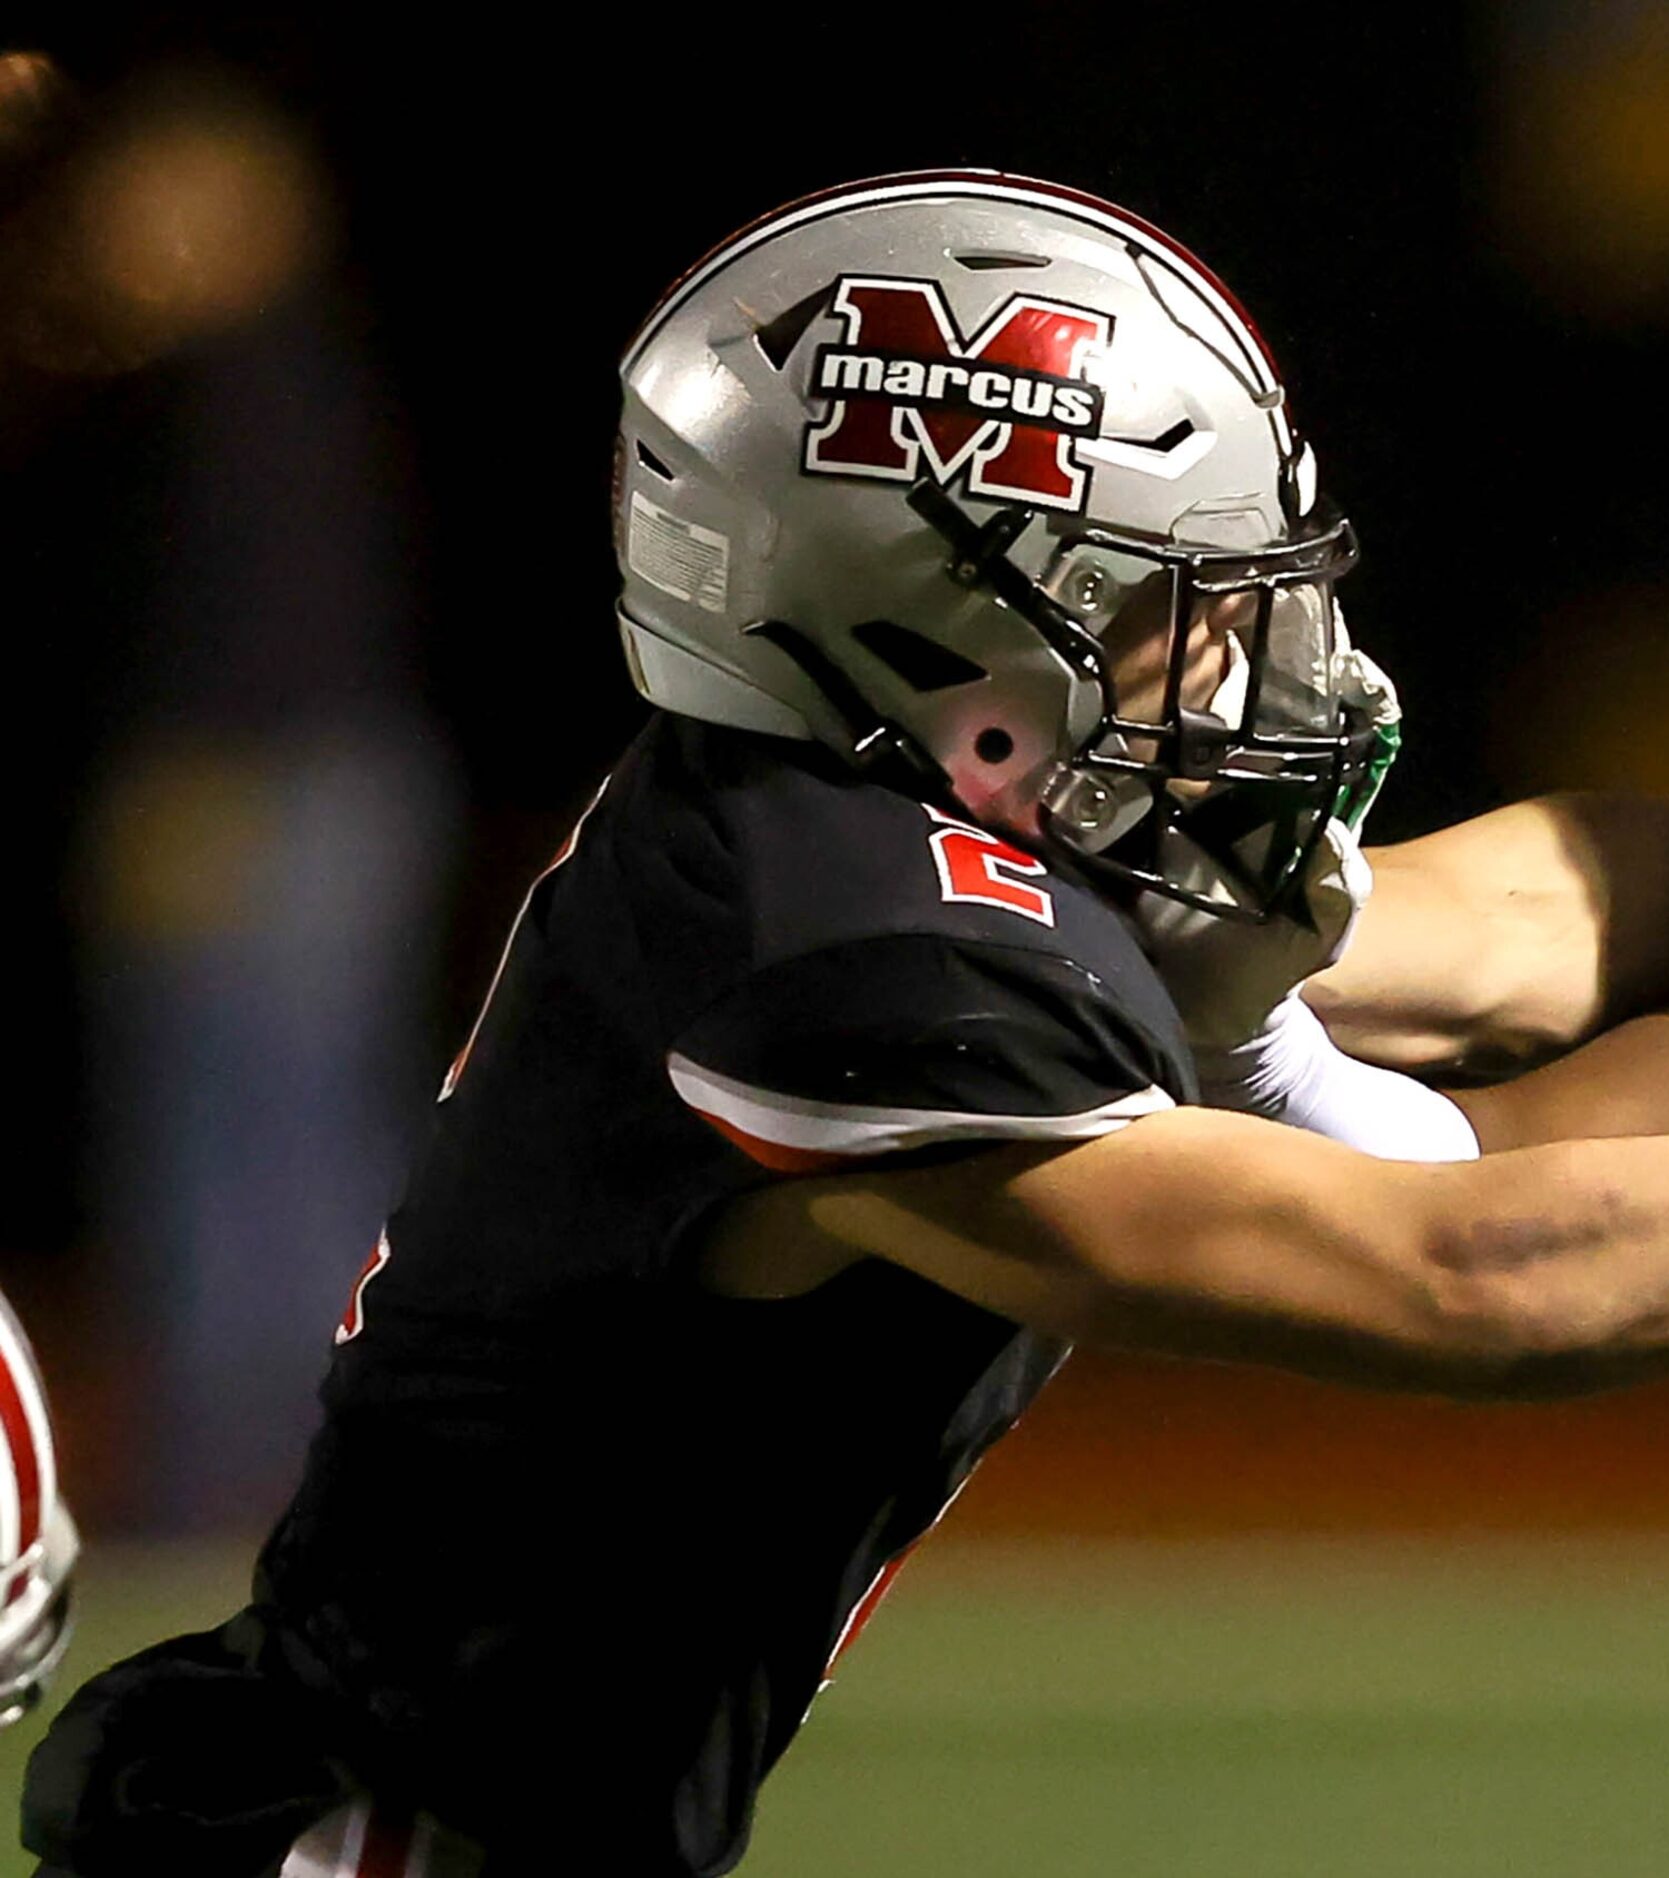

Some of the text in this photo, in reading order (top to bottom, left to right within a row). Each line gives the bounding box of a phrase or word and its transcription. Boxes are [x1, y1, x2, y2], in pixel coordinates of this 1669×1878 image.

[803, 274, 1115, 511] M
[820, 353, 1095, 427] marcus
[920, 802, 1055, 929] 2
